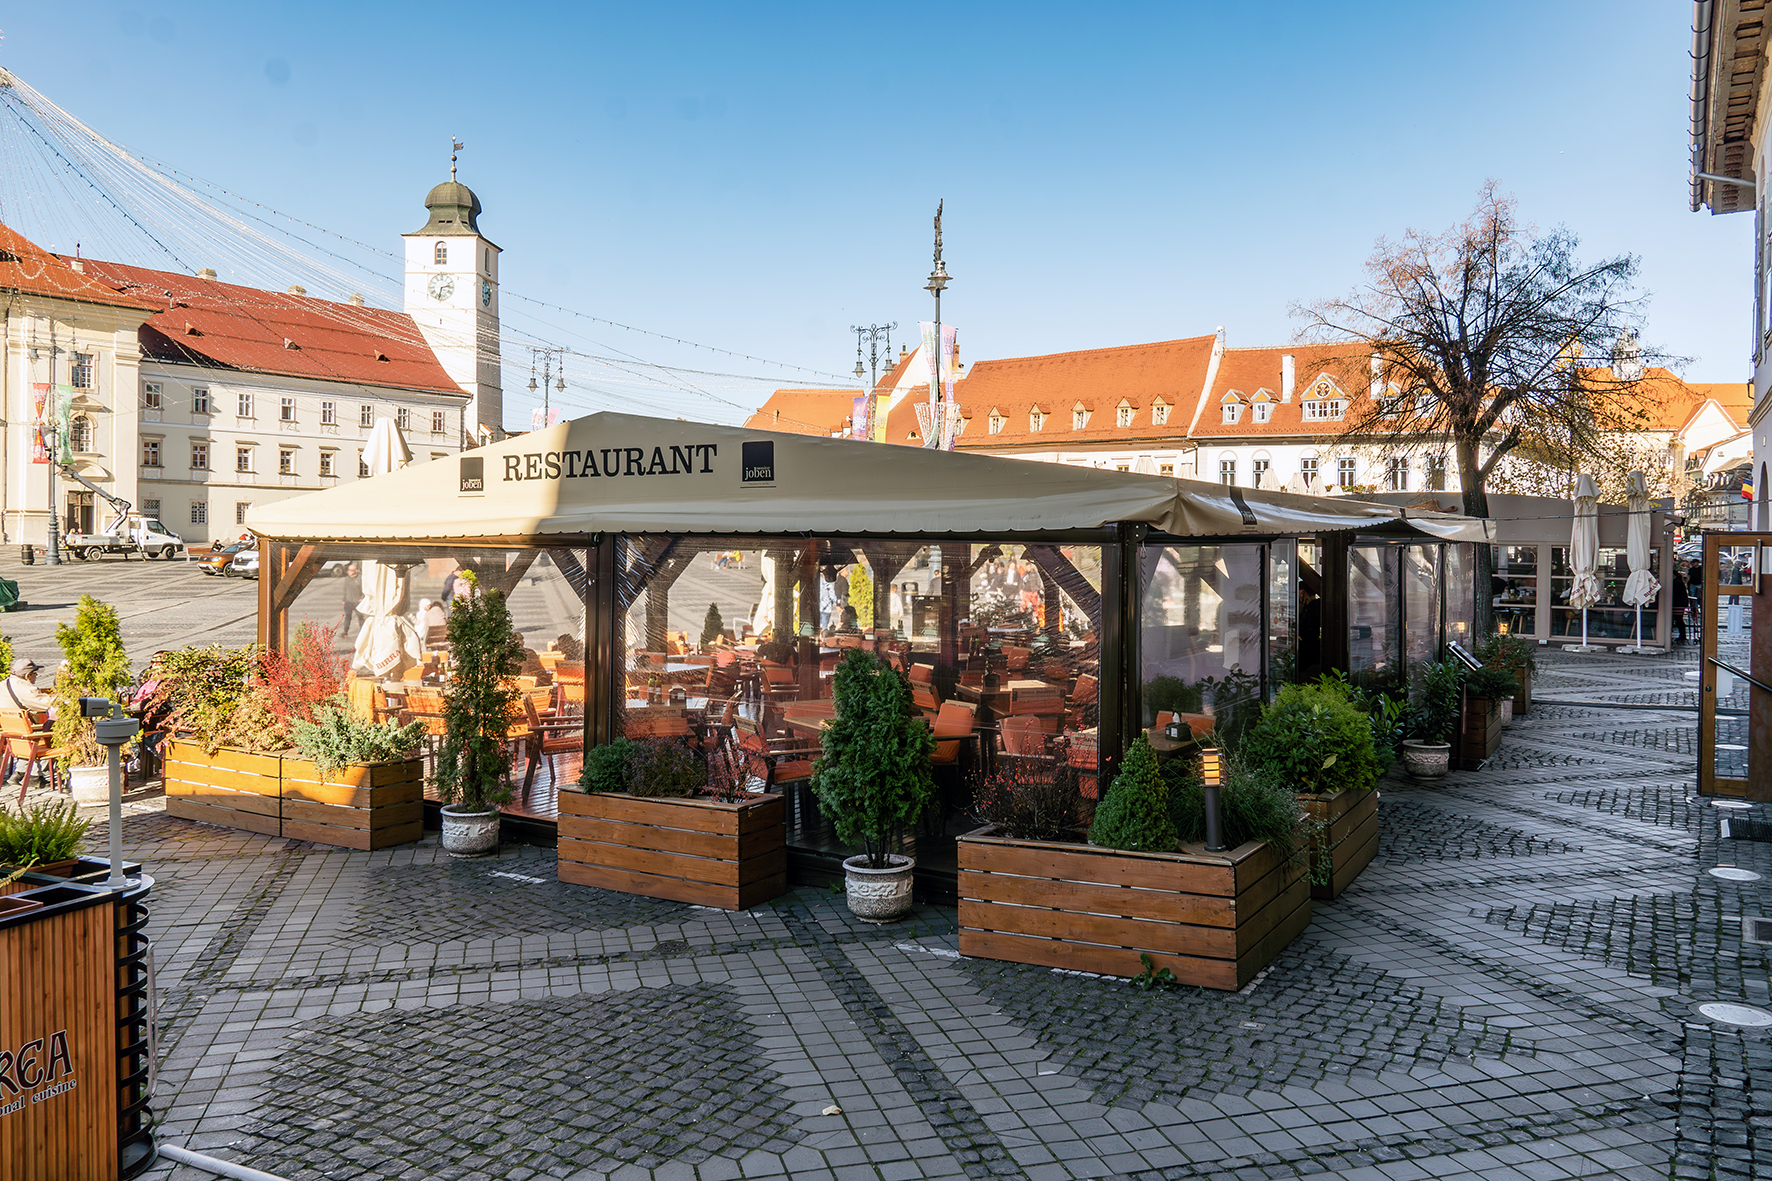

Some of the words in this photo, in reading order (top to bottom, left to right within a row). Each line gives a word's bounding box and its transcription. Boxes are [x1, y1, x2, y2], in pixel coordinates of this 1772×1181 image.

[502, 443, 718, 482] RESTAURANT
[744, 466, 771, 480] joben
[461, 478, 482, 491] joben
[375, 649, 401, 670] BIRRA
[32, 1079, 77, 1104] cuisine
